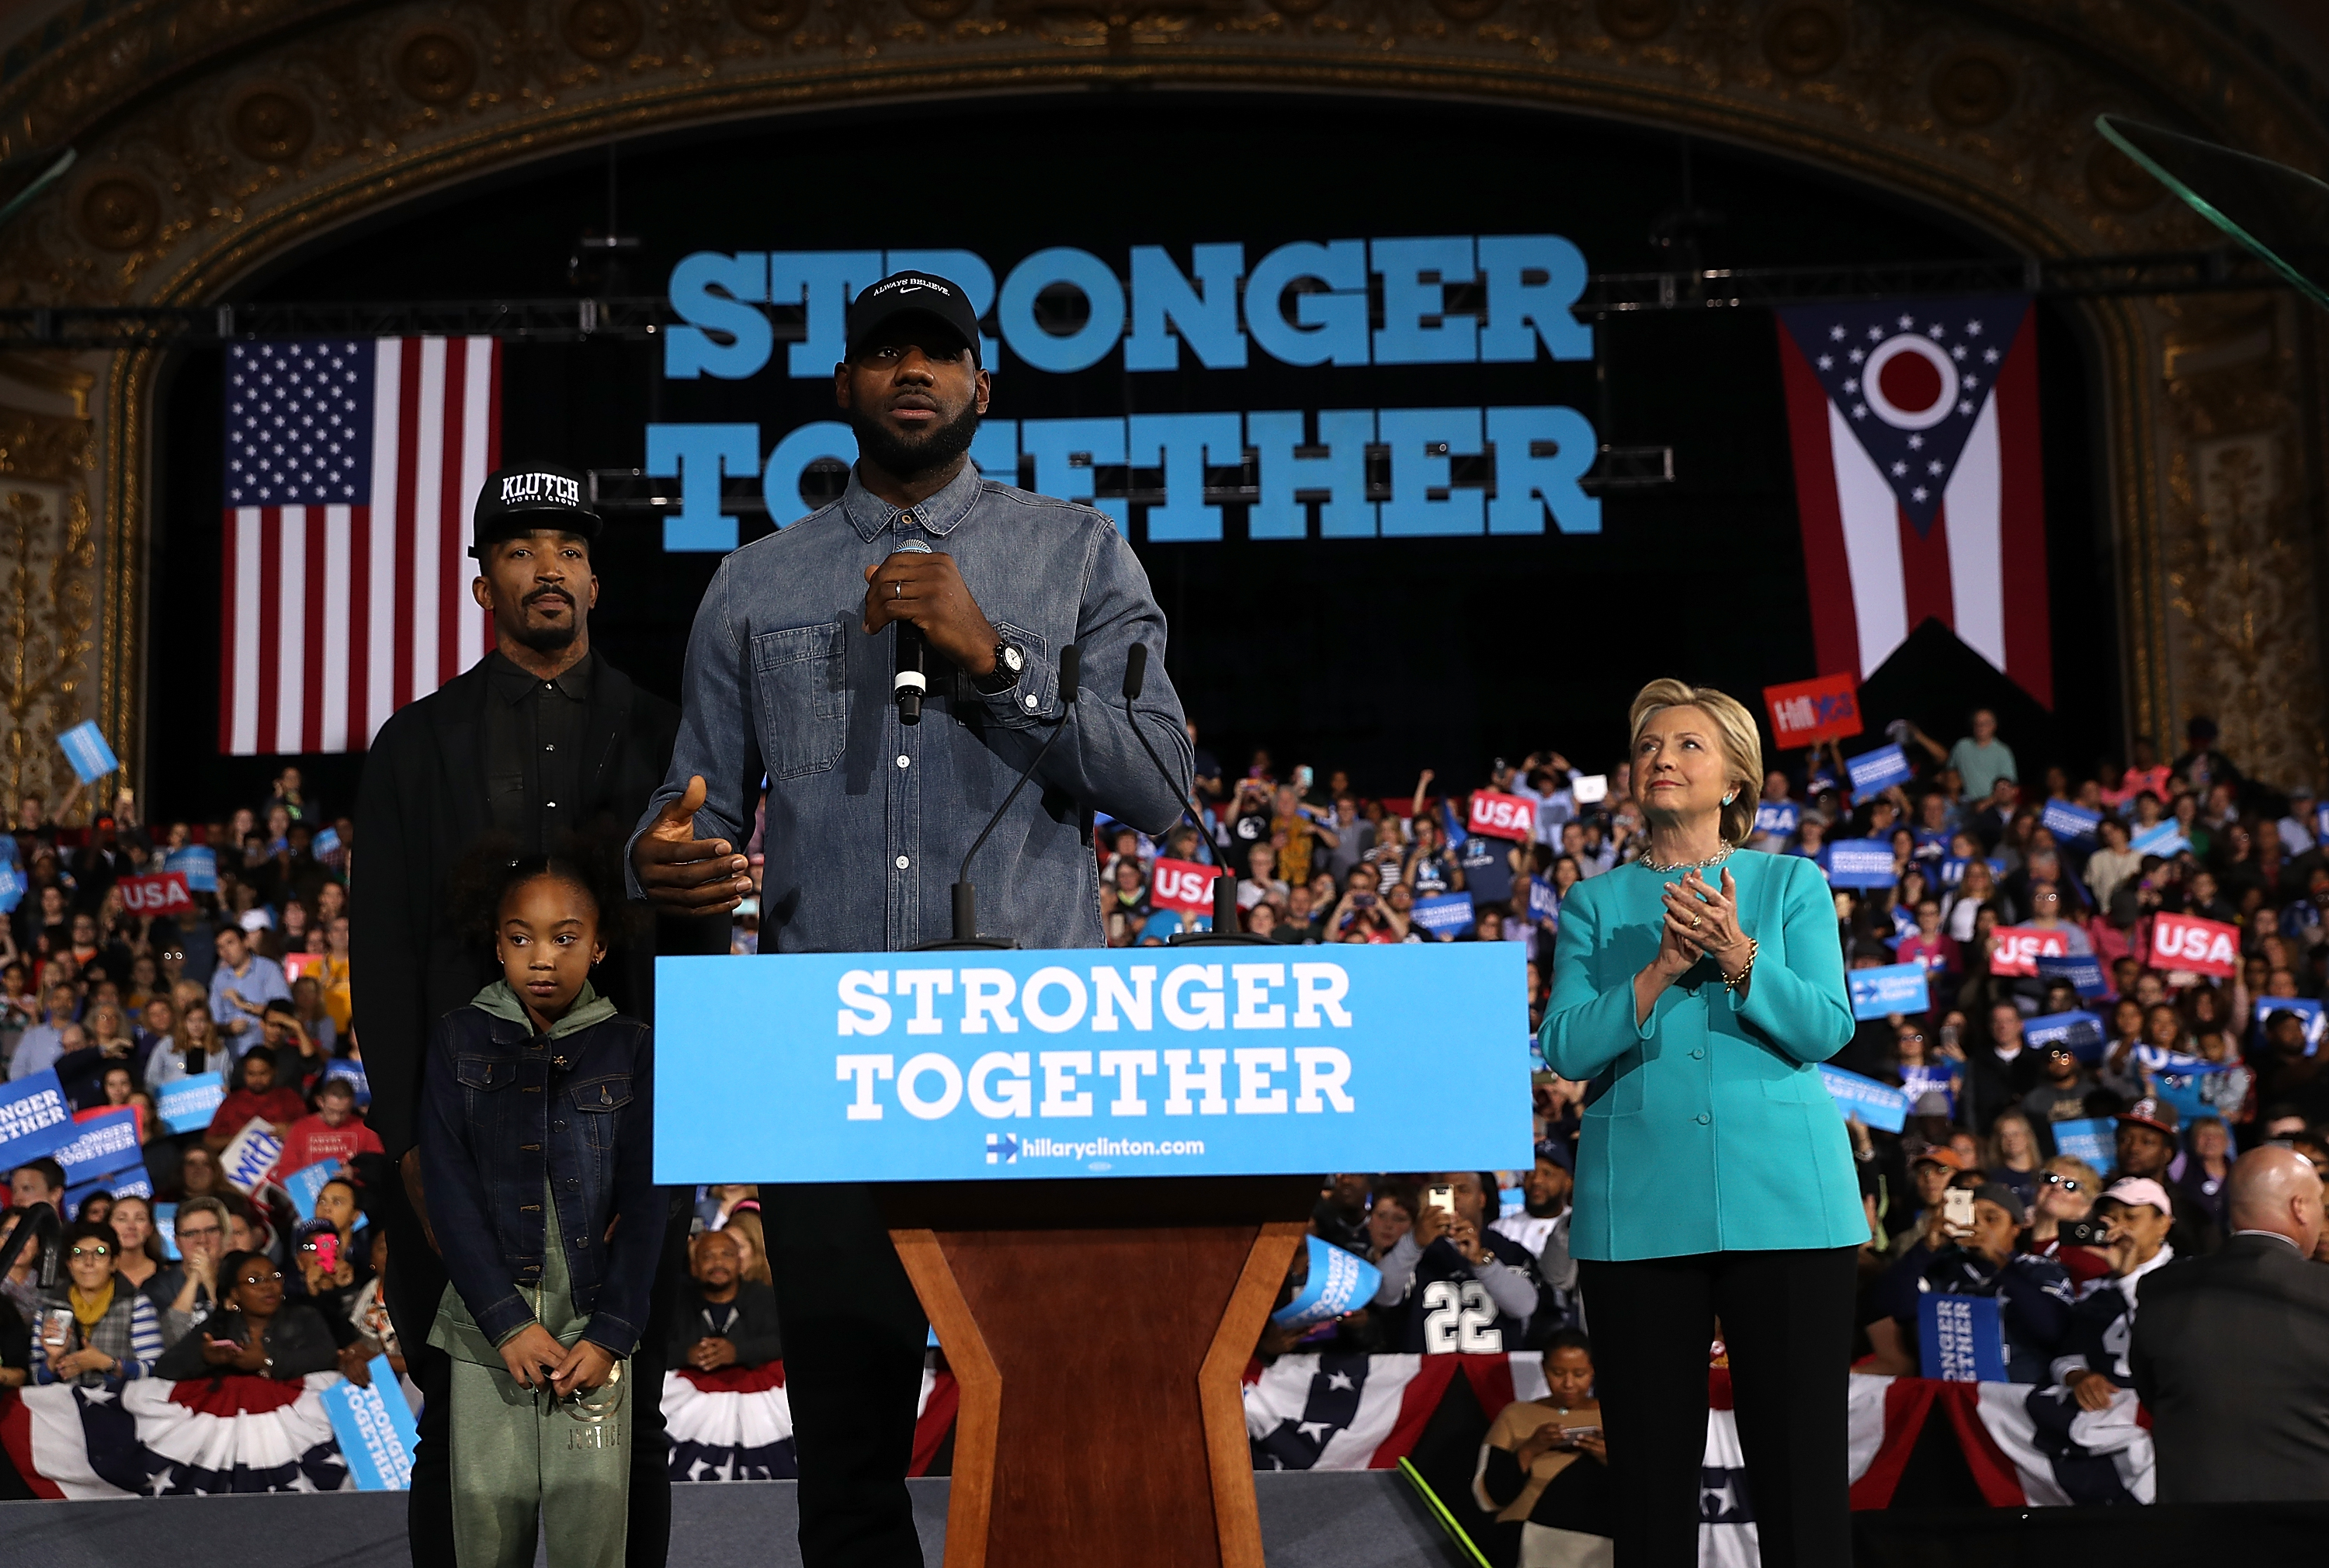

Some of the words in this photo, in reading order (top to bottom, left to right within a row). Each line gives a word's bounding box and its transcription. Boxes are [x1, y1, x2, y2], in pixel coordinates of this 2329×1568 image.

[873, 278, 908, 297] ALWAYS
[910, 278, 951, 297] BELIEVE.
[501, 473, 580, 502] KLUTCH
[647, 408, 1601, 551] TOETHER
[506, 494, 541, 505] SPORTS
[547, 495, 577, 507] GROUP
[1472, 798, 1531, 830] USA
[122, 879, 189, 910] USA
[2155, 923, 2235, 965] USA
[838, 963, 1352, 1036] STRONGER
[837, 1048, 1355, 1119] TOGETHER
[1022, 1138, 1204, 1160] hillaryclinton.com
[1422, 1280, 1503, 1355] 22
[362, 1382, 411, 1486] TRONGER
[567, 1424, 621, 1451] JUSTICE
